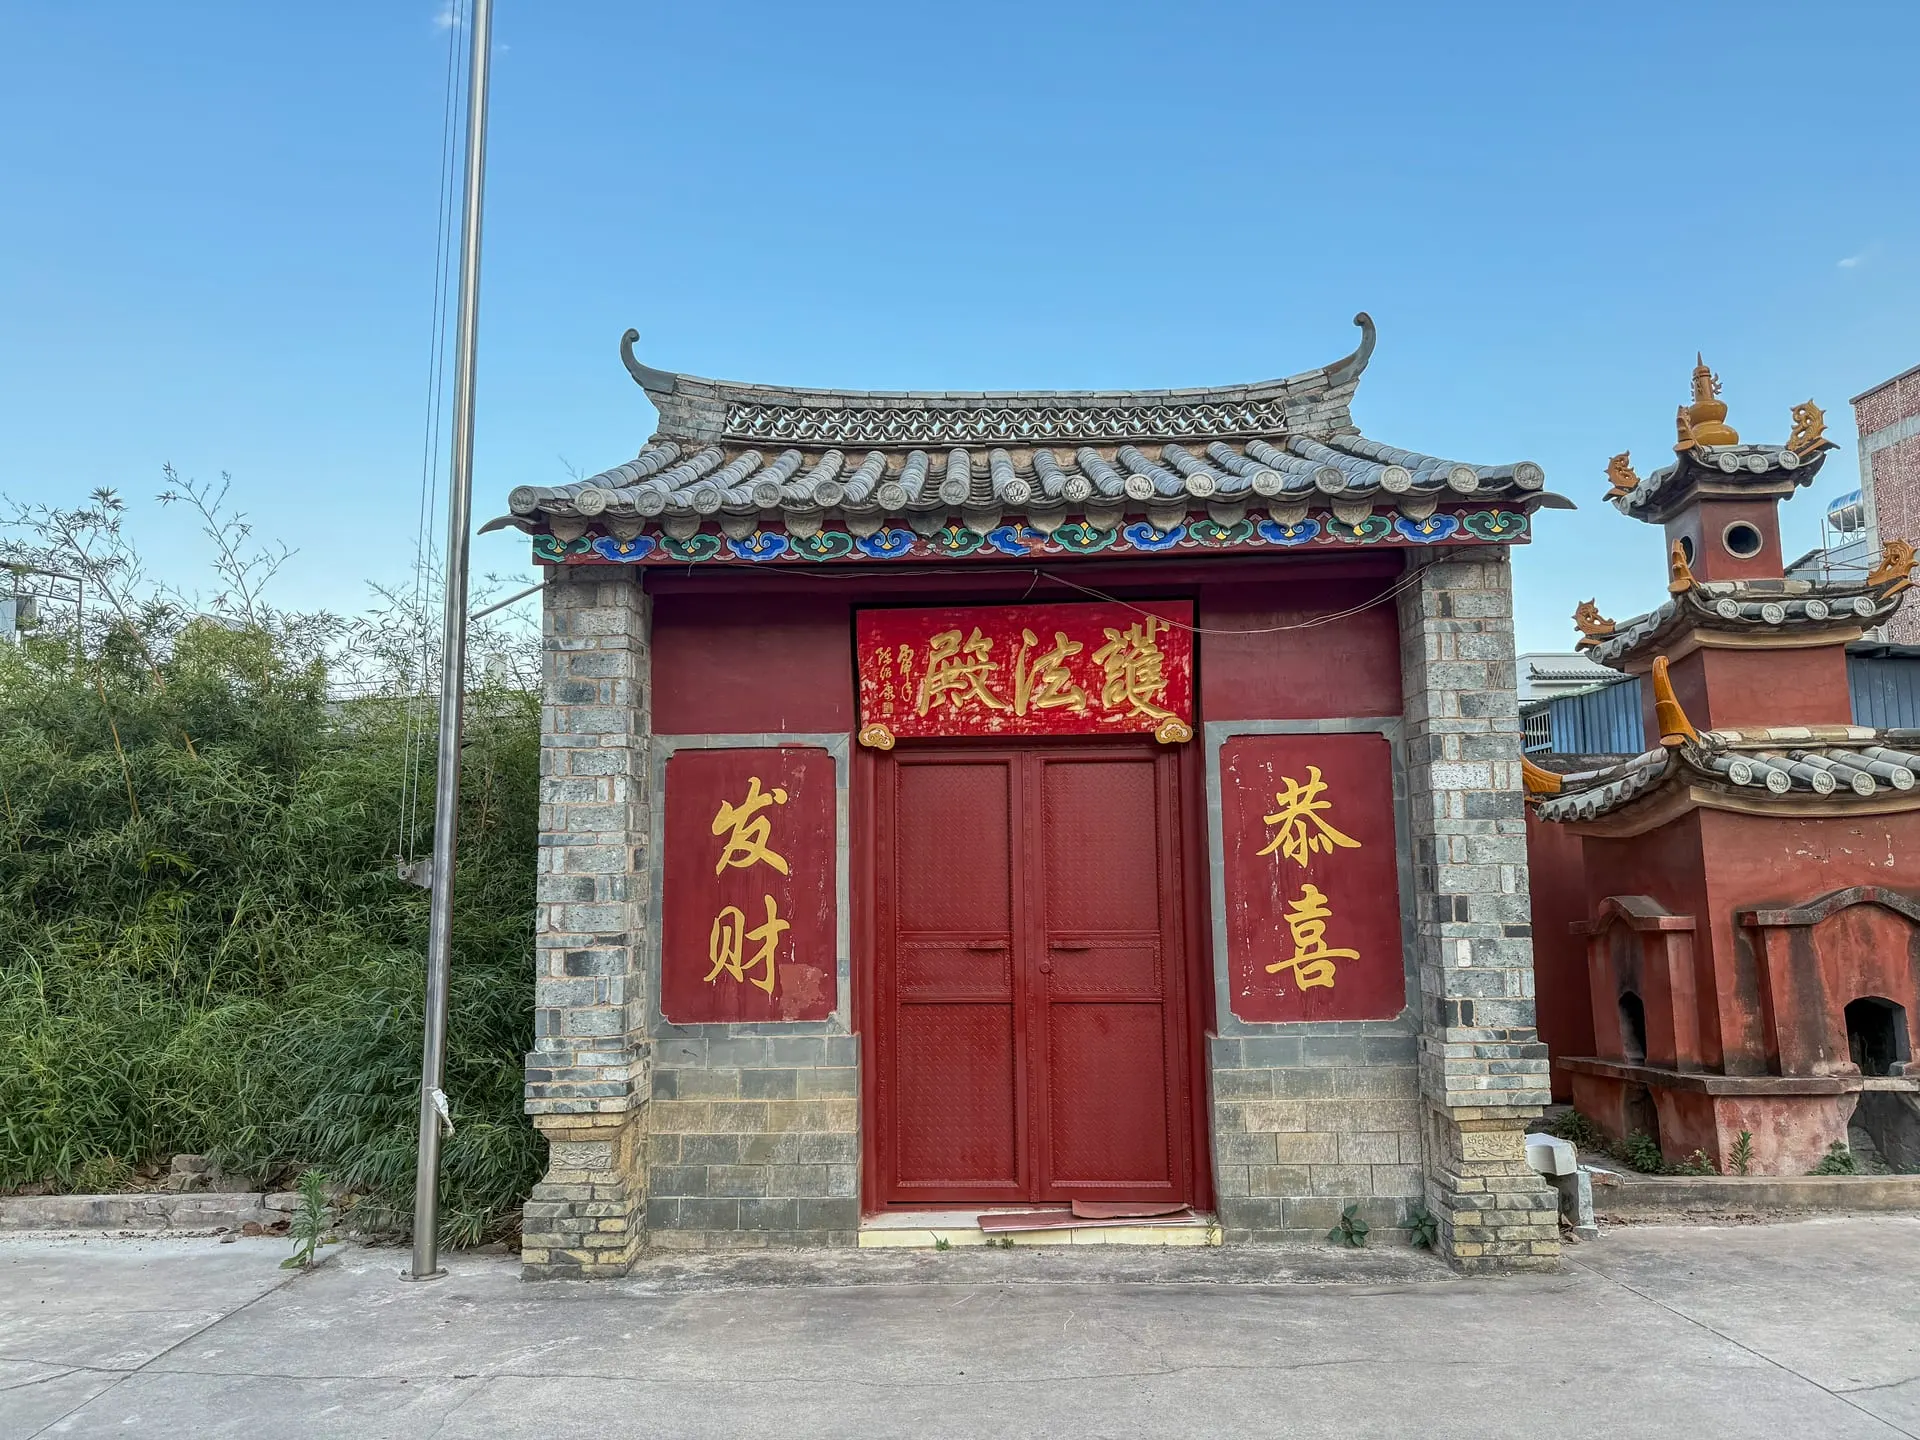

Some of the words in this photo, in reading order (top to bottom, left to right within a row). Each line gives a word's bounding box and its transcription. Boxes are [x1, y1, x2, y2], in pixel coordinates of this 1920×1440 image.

[918, 615, 1177, 718] 護法殿
[703, 776, 791, 993] 发财
[1255, 765, 1362, 991] 恭喜
